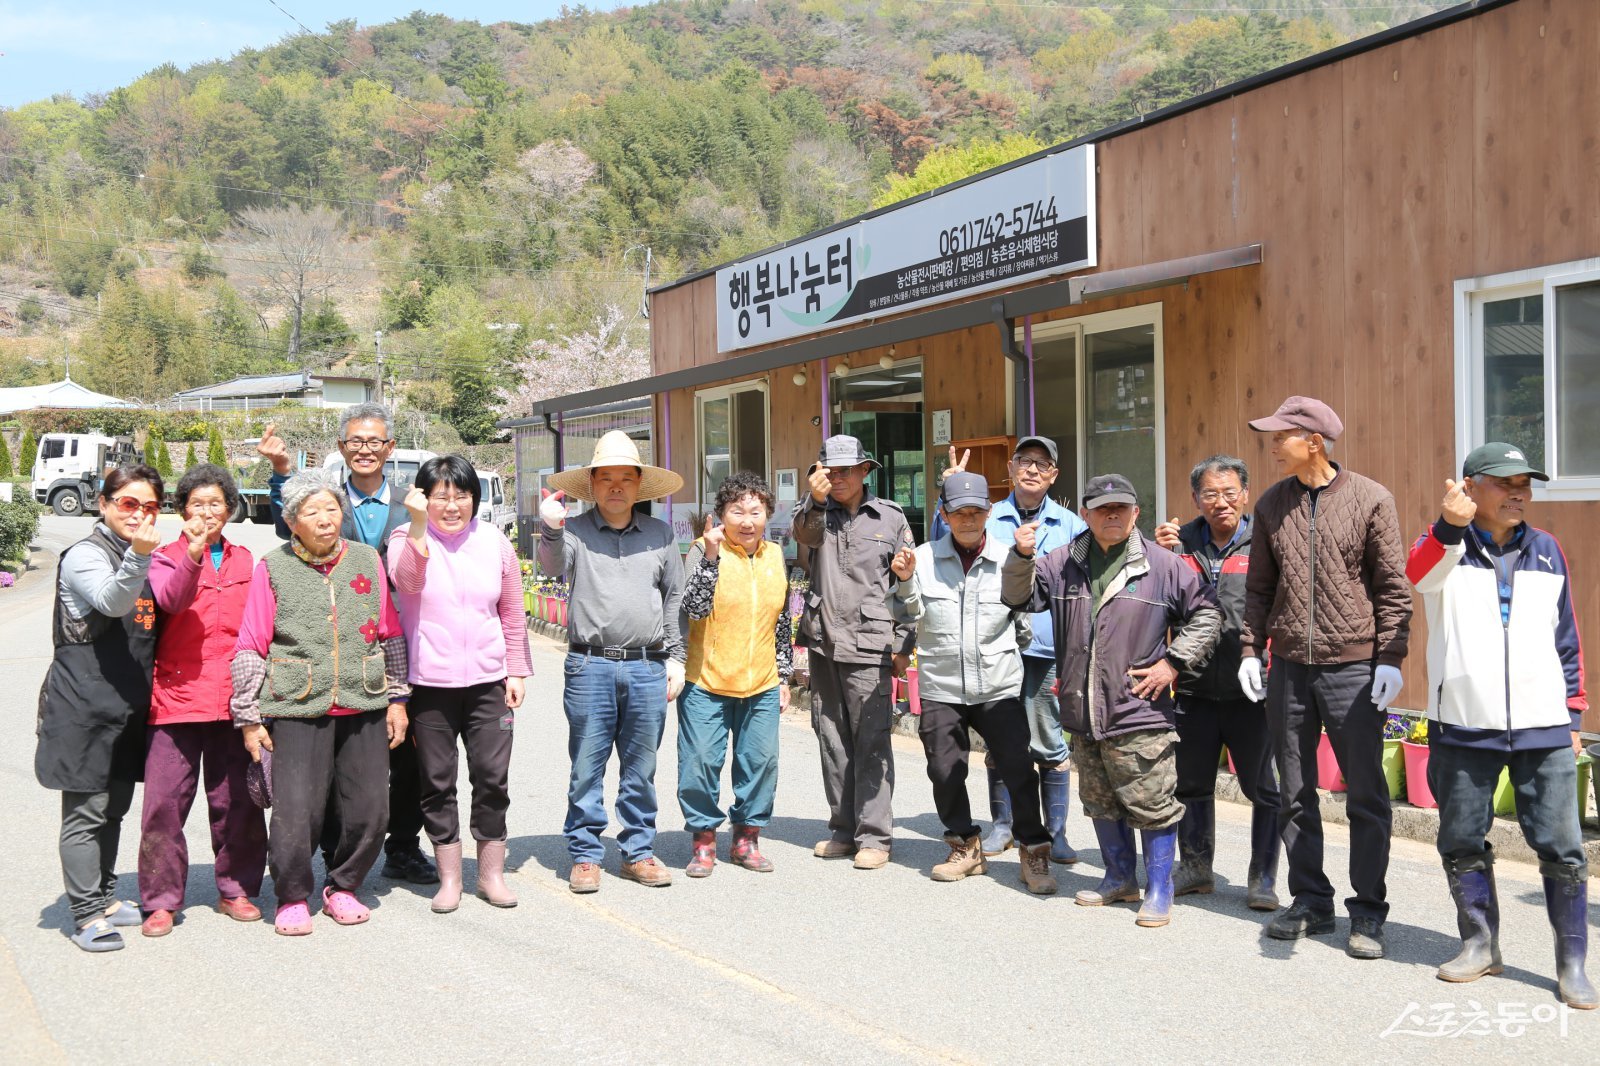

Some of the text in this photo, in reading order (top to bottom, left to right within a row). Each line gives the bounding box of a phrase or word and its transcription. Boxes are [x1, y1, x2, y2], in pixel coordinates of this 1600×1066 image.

[939, 196, 1058, 257] 061)742-5744
[729, 237, 852, 338] 행복나눔터
[897, 259, 953, 289] 농산물전시판매장
[961, 250, 983, 271] 편의점
[991, 229, 1058, 264] 농촌음식체험식당
[998, 264, 1012, 276] 김치류
